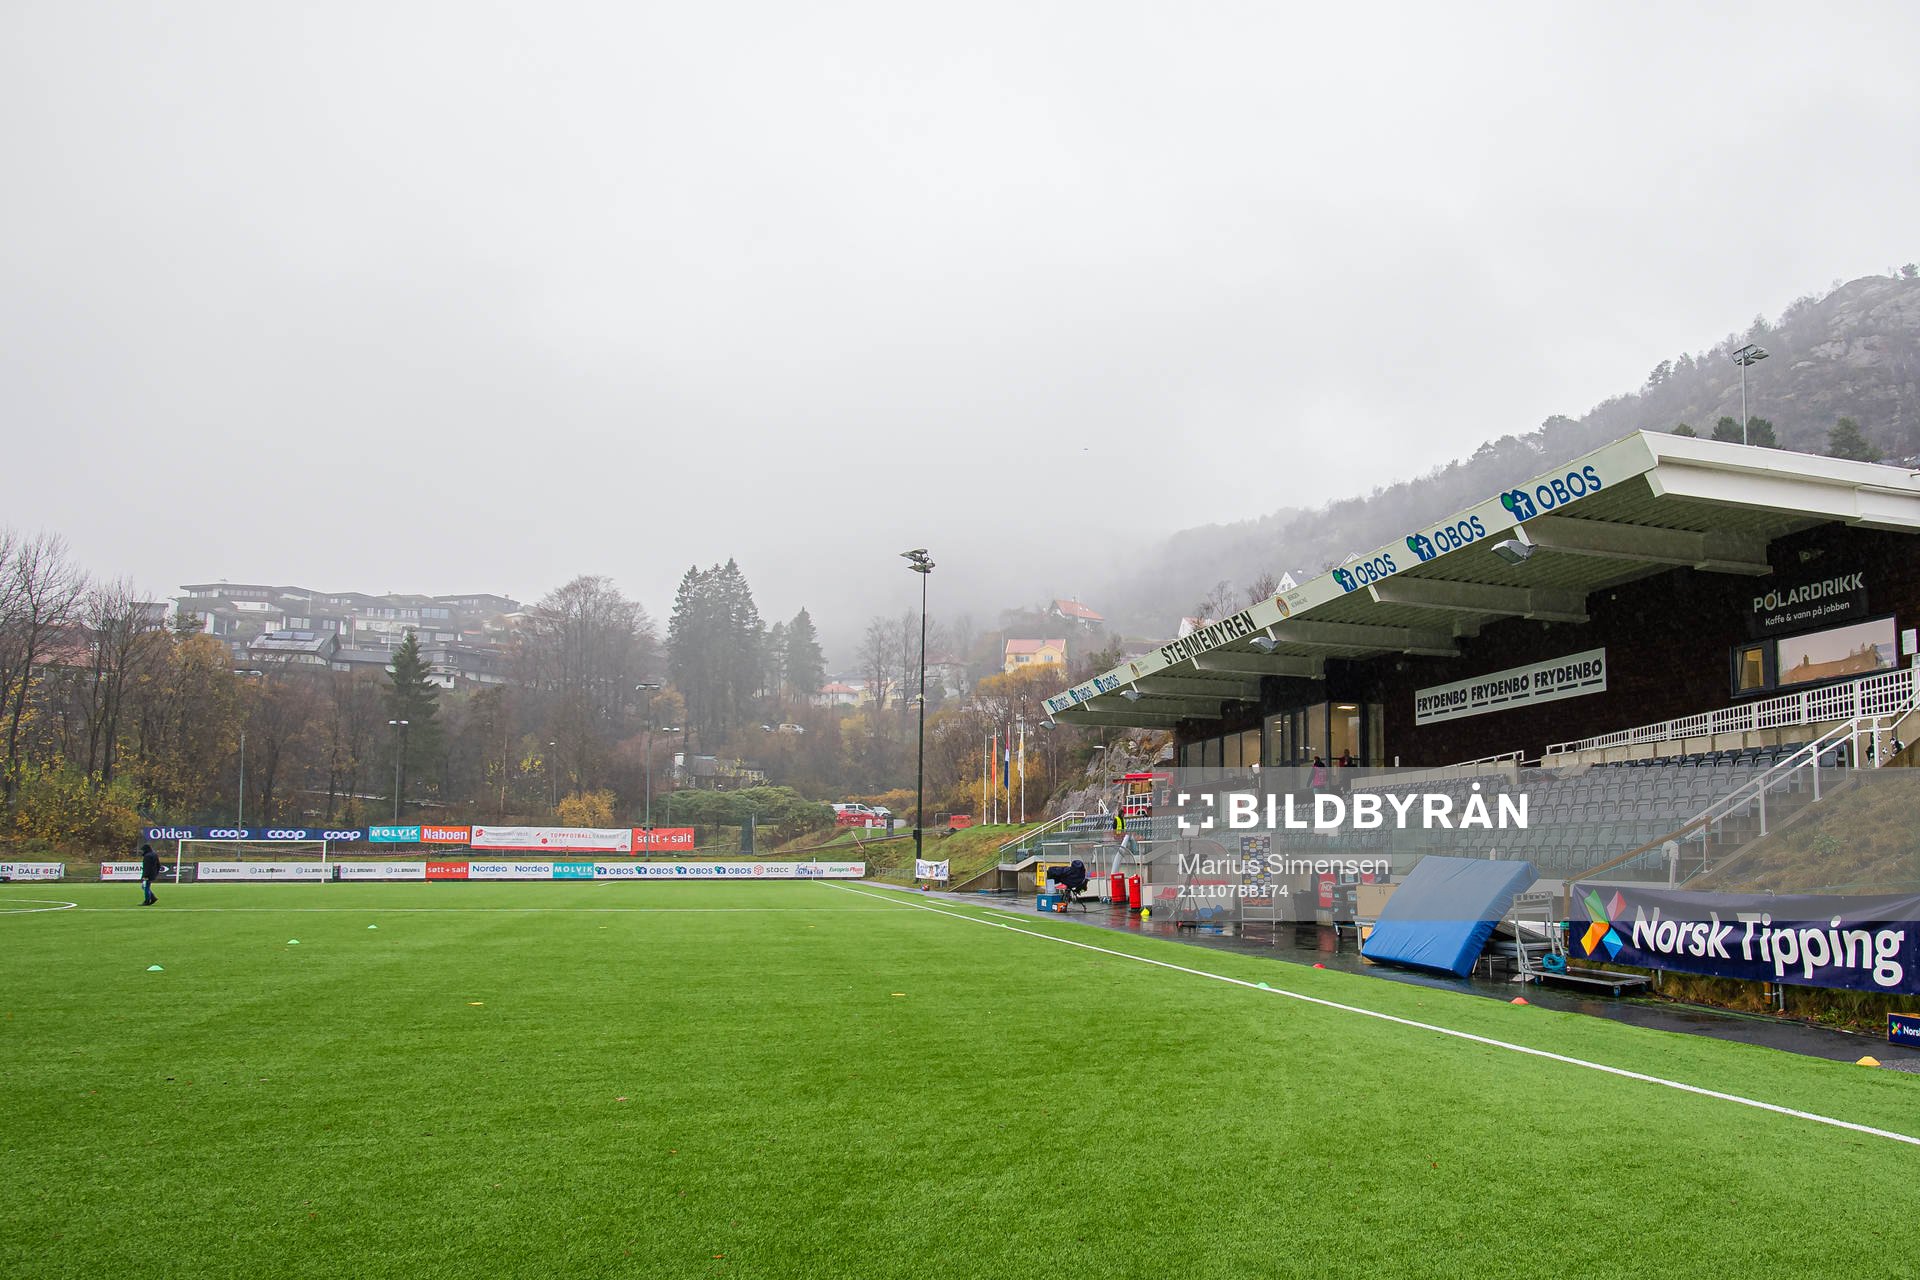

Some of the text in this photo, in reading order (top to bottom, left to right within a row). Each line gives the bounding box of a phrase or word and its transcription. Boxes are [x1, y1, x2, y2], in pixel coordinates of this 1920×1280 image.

[1536, 466, 1601, 509] OBOS
[1435, 515, 1486, 552] OBOS
[1355, 553, 1397, 585] OBOS
[1765, 601, 1850, 627] Kaffe & vann på jobben
[1161, 611, 1256, 665] STEMMEMYREN
[1103, 674, 1121, 690] OBOS
[1417, 657, 1603, 712] FRYDENBØ FRYDENBØ FRYDENBØ
[150, 828, 193, 839] Olden
[209, 829, 249, 840] coop
[267, 829, 307, 840] coop
[323, 830, 361, 841] coop
[371, 829, 418, 837] MOLVIK
[423, 828, 468, 840] Naboen
[671, 830, 692, 843] salt
[514, 865, 550, 873] Nordea
[554, 865, 593, 873] MOLVIK
[609, 867, 634, 875] OBOS
[649, 867, 674, 875] OBOS
[688, 867, 713, 875] OBOS
[728, 867, 752, 875] OBOS
[1632, 905, 1905, 986] Norsk Tipping
